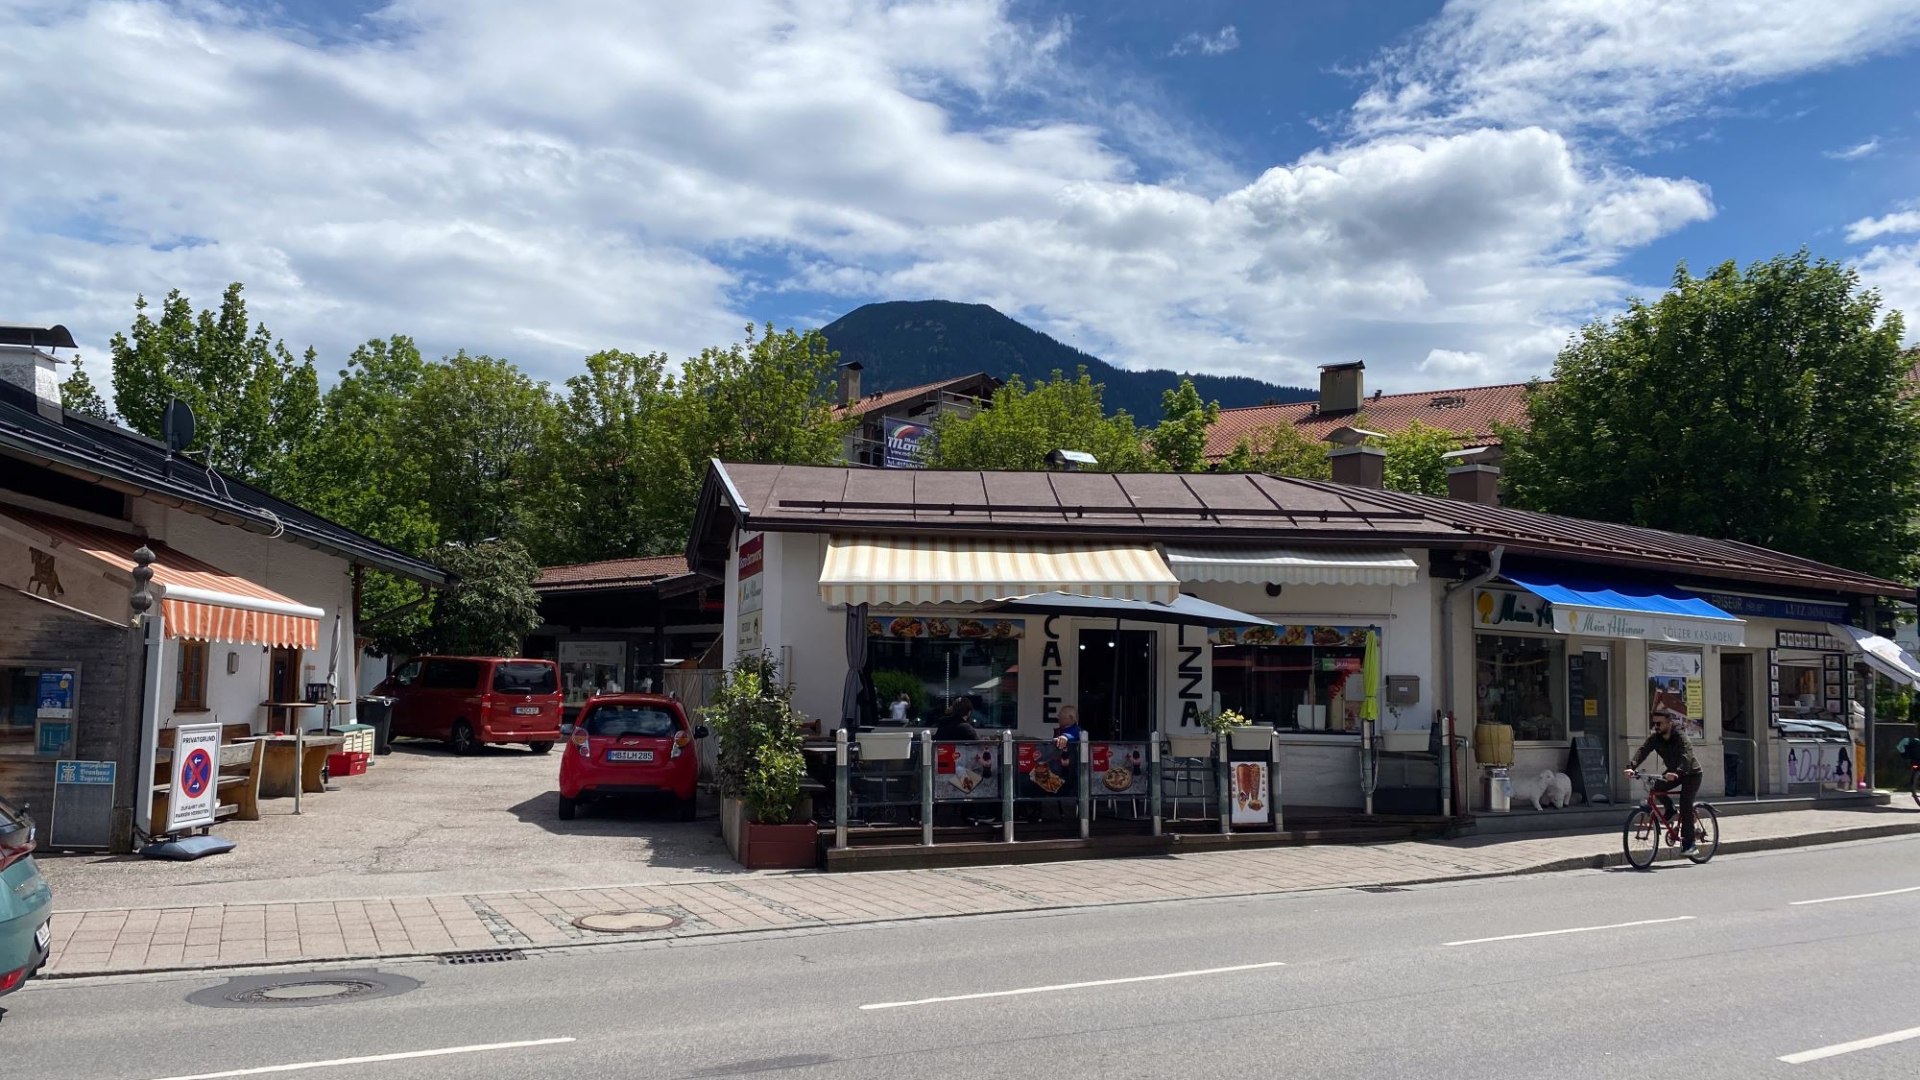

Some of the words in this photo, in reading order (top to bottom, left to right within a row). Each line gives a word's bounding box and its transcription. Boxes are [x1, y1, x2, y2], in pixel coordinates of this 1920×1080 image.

[1712, 595, 1742, 611] FRISEUR
[1582, 612, 1606, 632] Mein
[1608, 615, 1645, 636] Affineur
[1178, 623, 1202, 727] IZZA
[183, 735, 215, 743] PRIVATGRUND
[638, 752, 652, 760] 285
